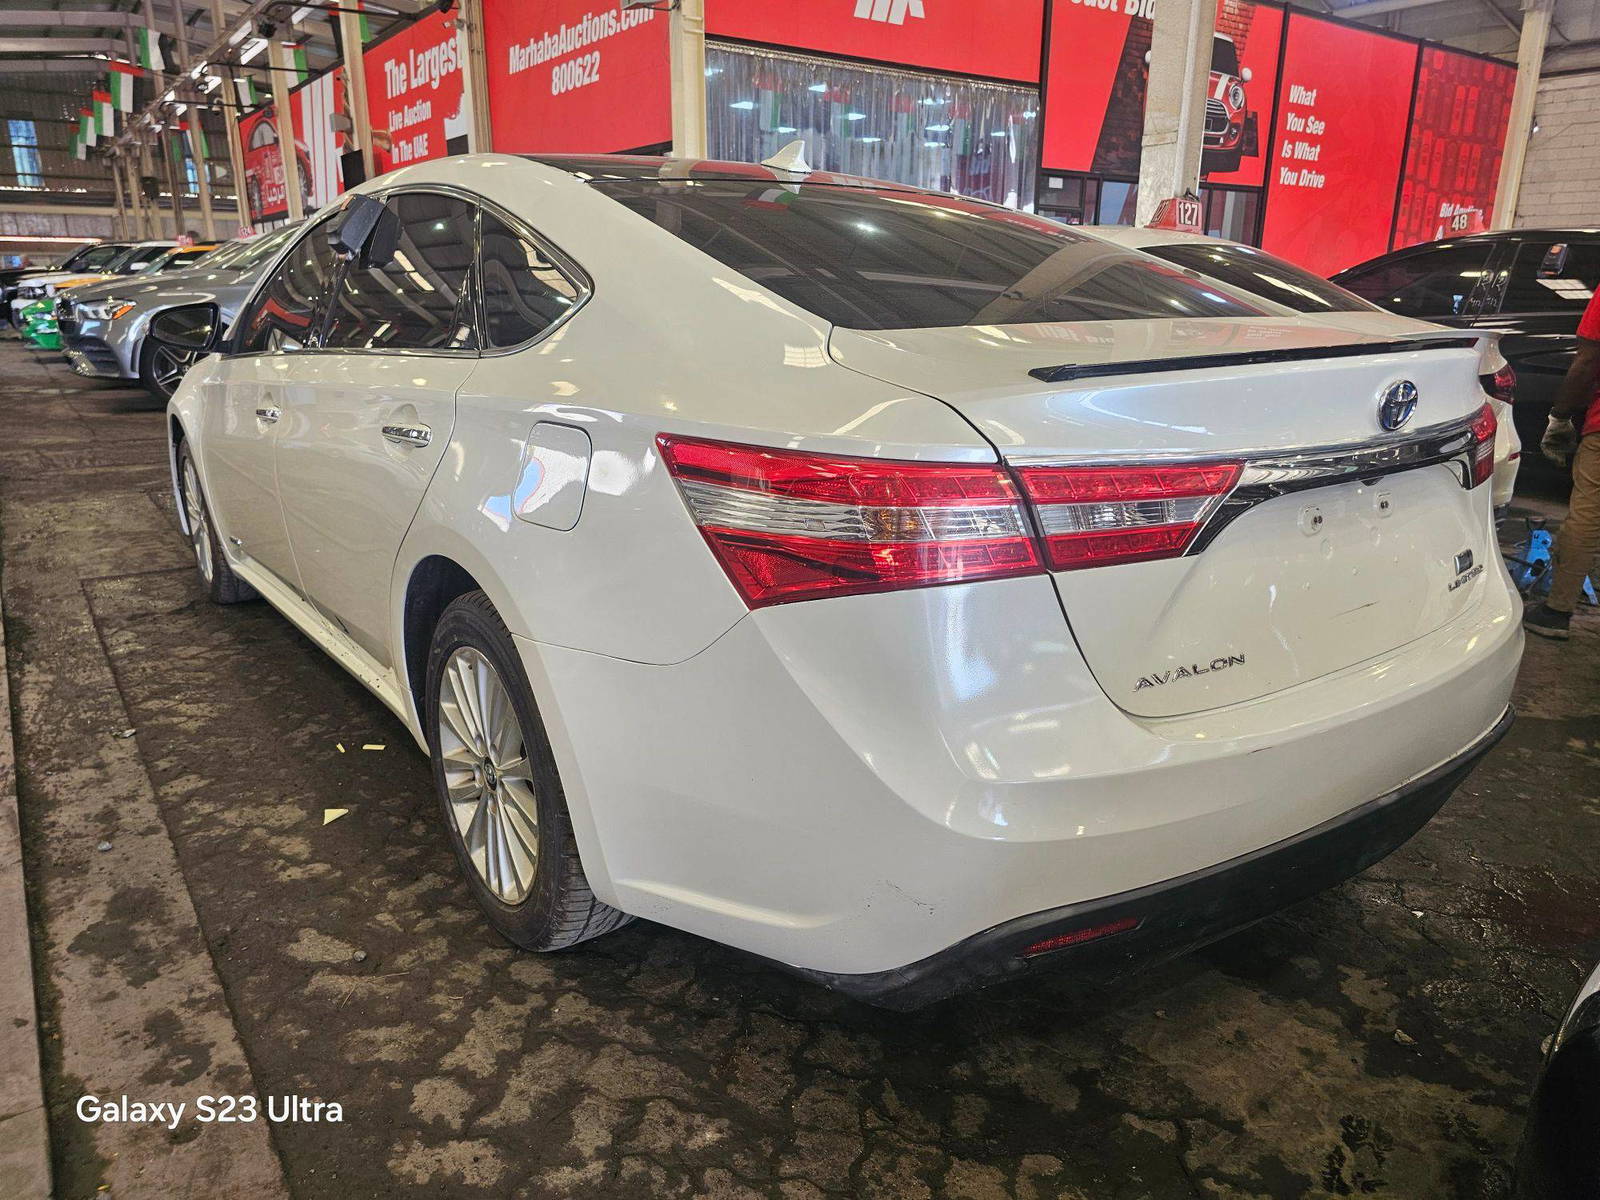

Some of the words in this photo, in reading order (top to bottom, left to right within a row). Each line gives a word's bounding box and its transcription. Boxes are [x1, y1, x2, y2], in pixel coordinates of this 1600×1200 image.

[508, 6, 655, 75] MarhabaAuctions.com
[384, 58, 407, 99] The
[551, 51, 600, 96] 800622
[1289, 84, 1317, 106] What
[389, 109, 403, 132] Live
[403, 99, 431, 126] Auction
[1286, 112, 1305, 132] You
[1306, 115, 1325, 135] See
[400, 139, 413, 162] The
[413, 132, 429, 159] UAE
[1281, 139, 1293, 158] Is
[1293, 141, 1320, 162] What
[1279, 166, 1298, 185] You
[1299, 168, 1325, 188] Drive
[1179, 201, 1198, 226] 127
[1439, 202, 1454, 217] Bid
[1452, 214, 1467, 231] 48
[1132, 653, 1246, 692] AVALON
